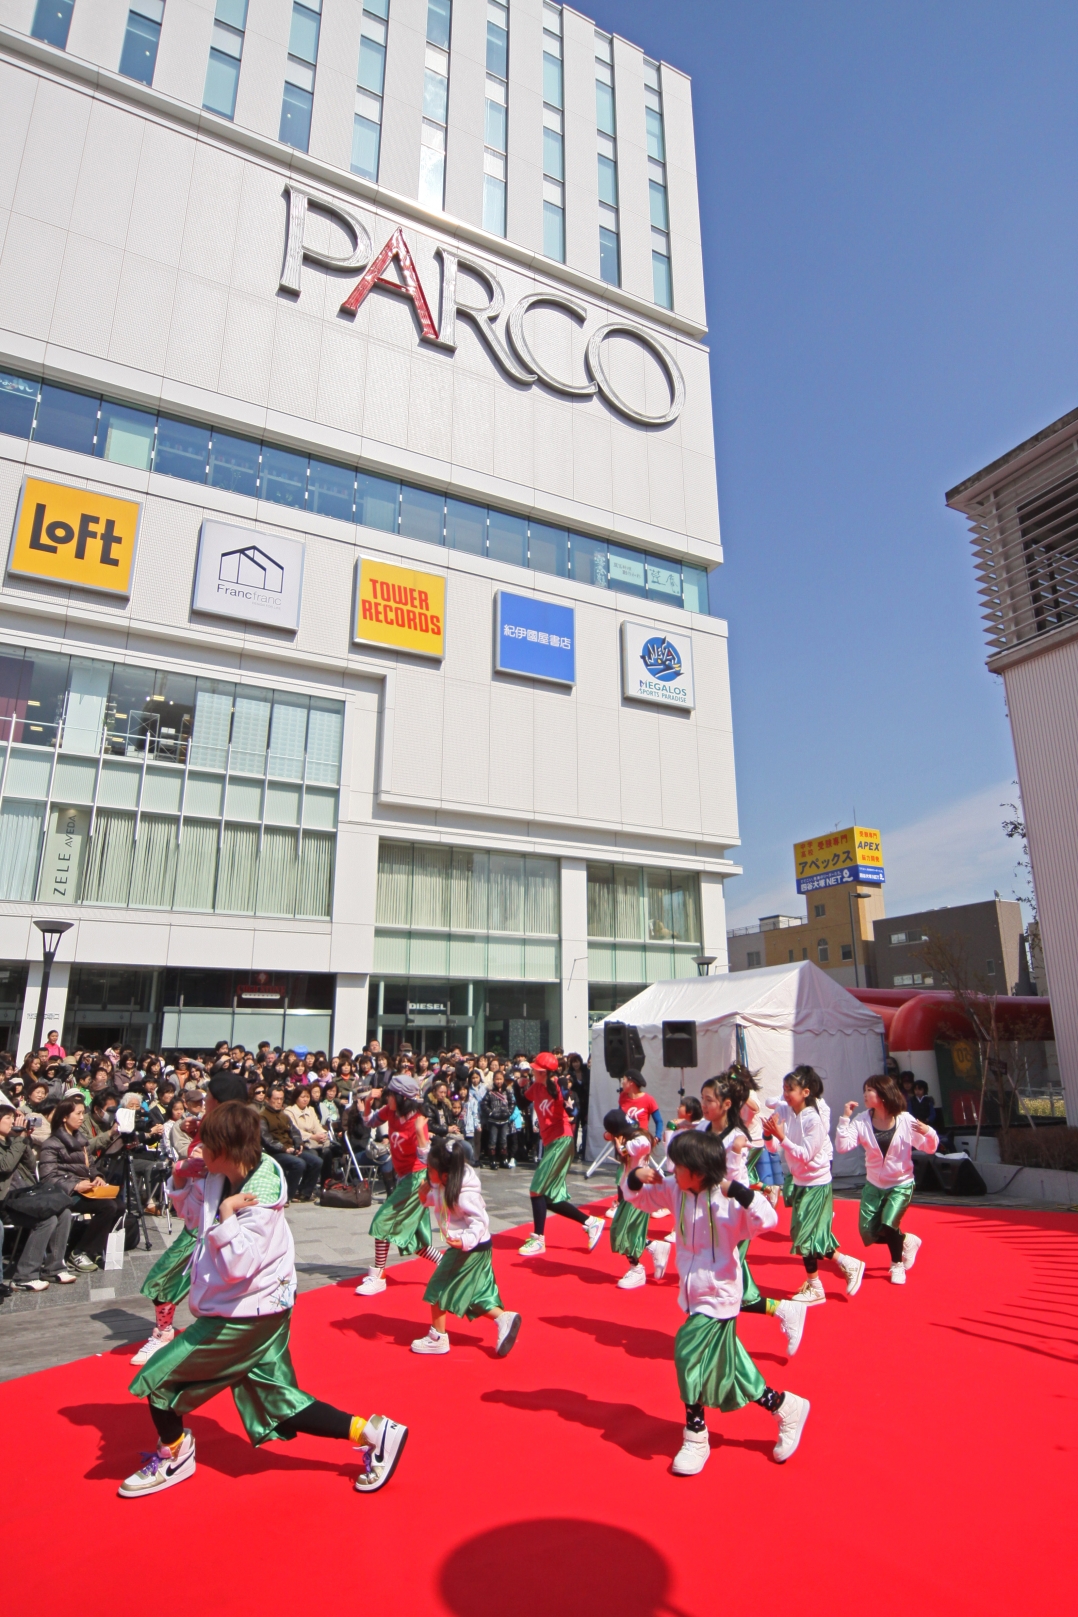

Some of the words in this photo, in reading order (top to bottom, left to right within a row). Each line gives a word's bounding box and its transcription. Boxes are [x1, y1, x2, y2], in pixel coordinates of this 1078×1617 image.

[278, 182, 686, 426] PARCO
[216, 583, 282, 606] Francfranc
[369, 578, 430, 611] TOWER
[361, 598, 442, 636] RECORDS
[503, 624, 571, 650] 紀伊國屋書店
[637, 687, 660, 698] SPORTS
[661, 692, 687, 704] PARADISE
[639, 679, 687, 697] MEGALOS
[65, 814, 77, 848] AVEDA
[857, 841, 880, 851] APEX
[53, 853, 72, 897] ZELE
[799, 850, 853, 875] アペックス
[826, 875, 841, 886] NET
